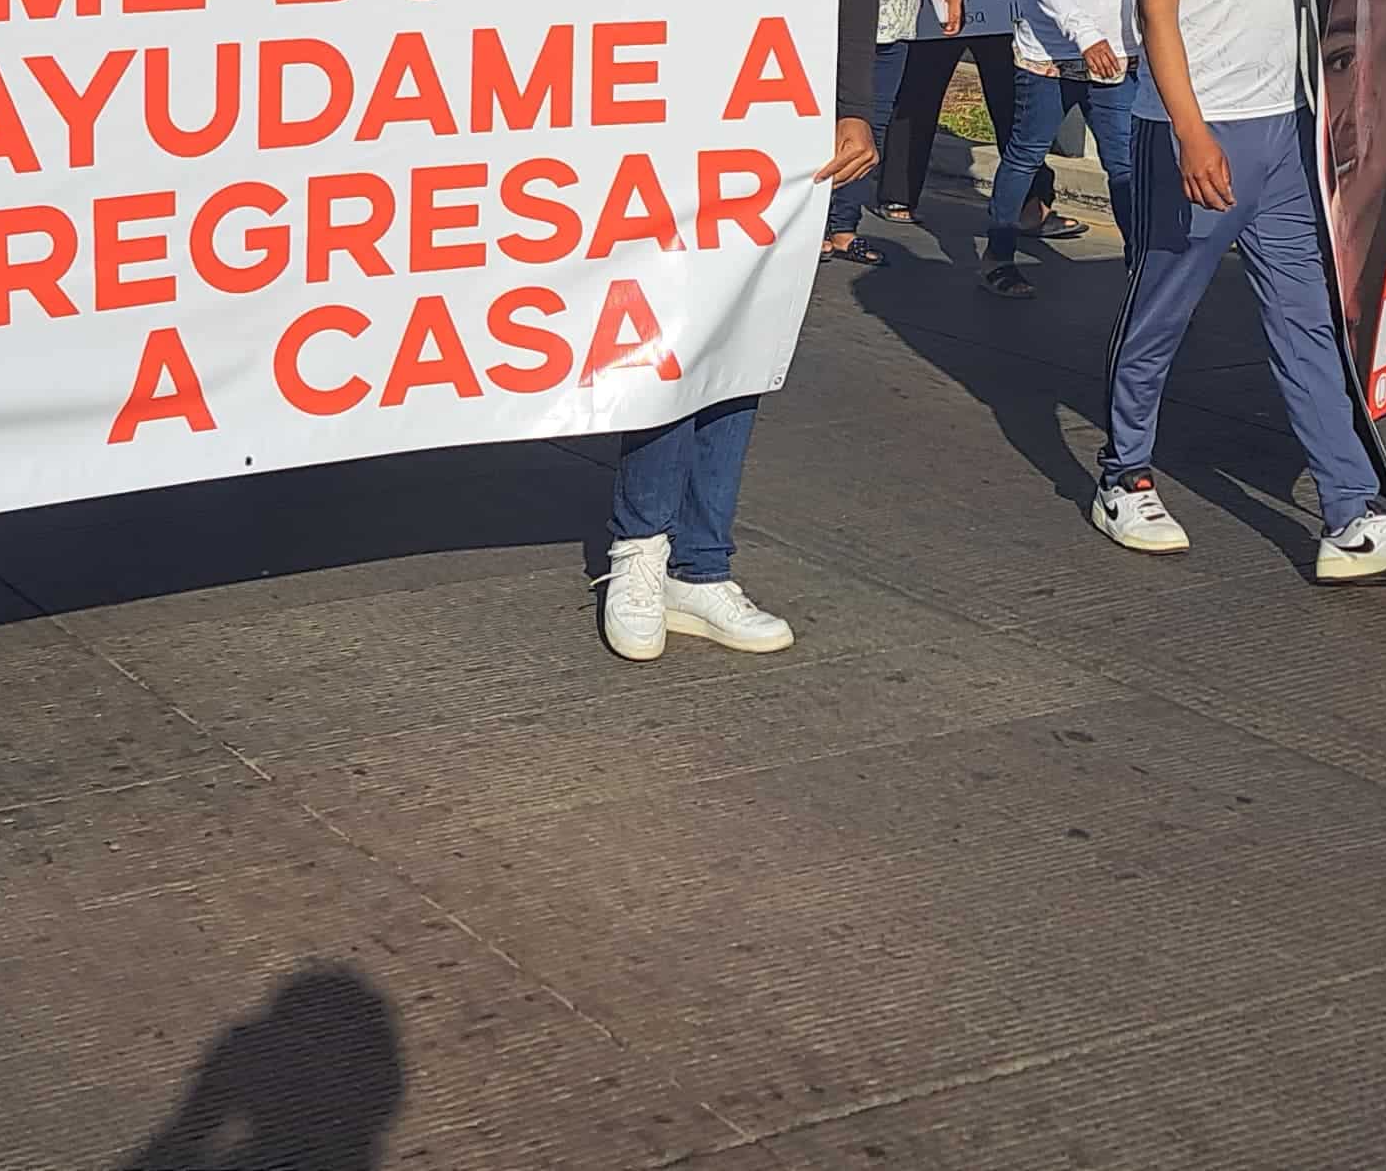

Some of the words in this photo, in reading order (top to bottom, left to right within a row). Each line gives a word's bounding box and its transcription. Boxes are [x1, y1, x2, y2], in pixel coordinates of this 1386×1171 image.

[721, 17, 821, 121] A
[106, 327, 218, 445] A
[272, 278, 682, 417] CASA
